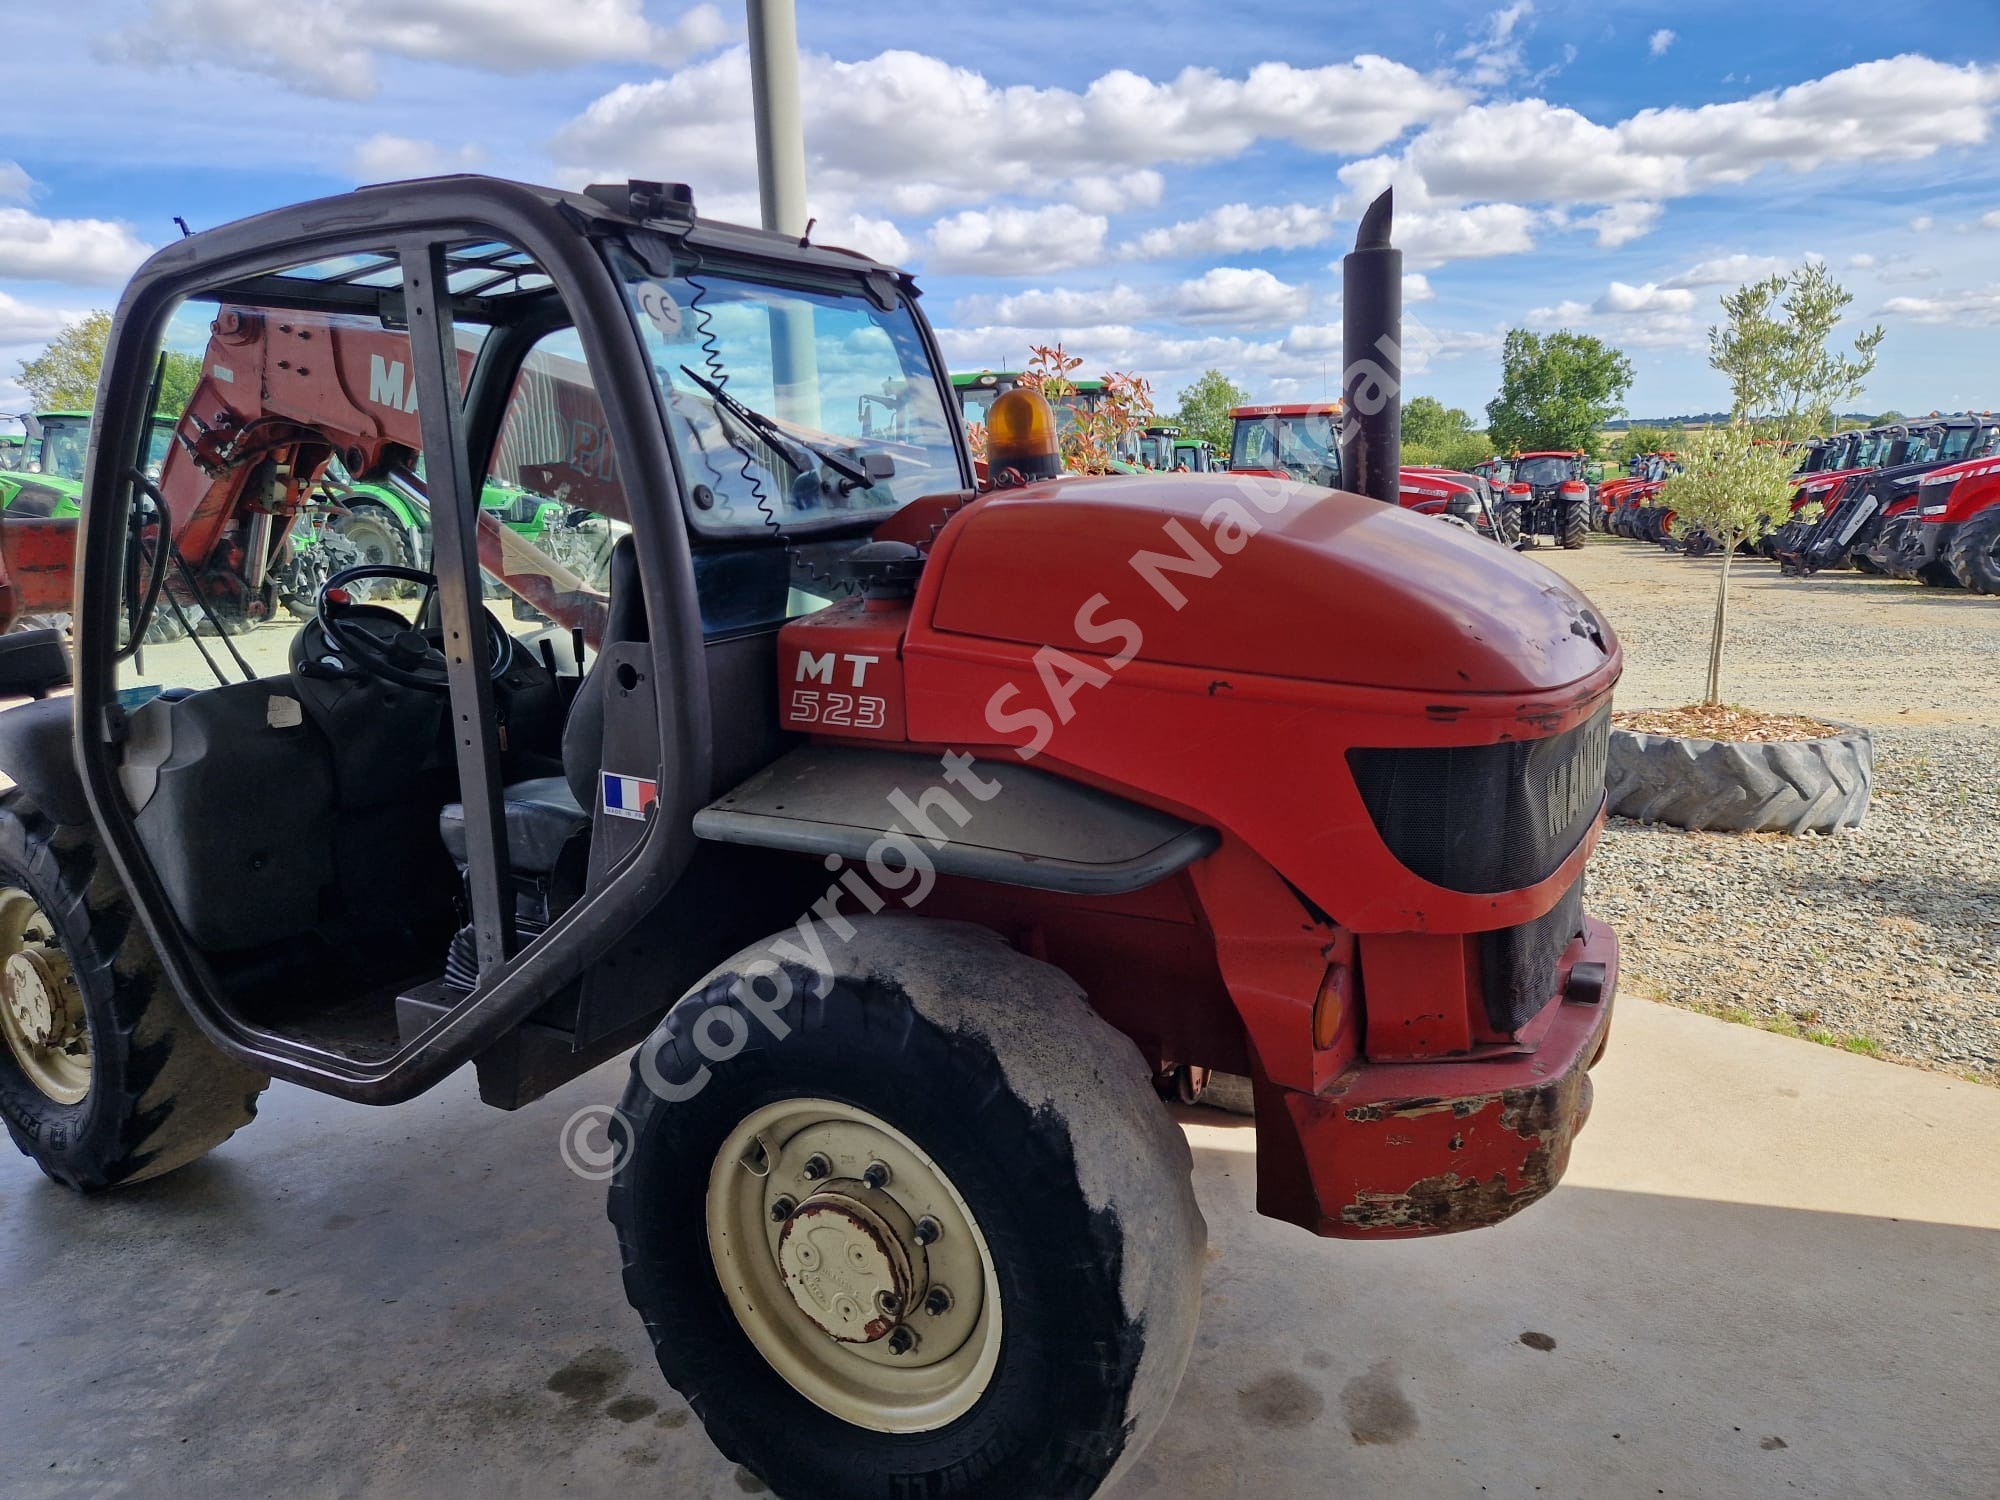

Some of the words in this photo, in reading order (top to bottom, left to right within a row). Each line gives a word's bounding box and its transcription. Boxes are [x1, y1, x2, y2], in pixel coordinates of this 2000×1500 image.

[643, 294, 677, 323] CE
[795, 650, 879, 688] MT
[790, 690, 886, 728] 523
[606, 807, 621, 816] MADE
